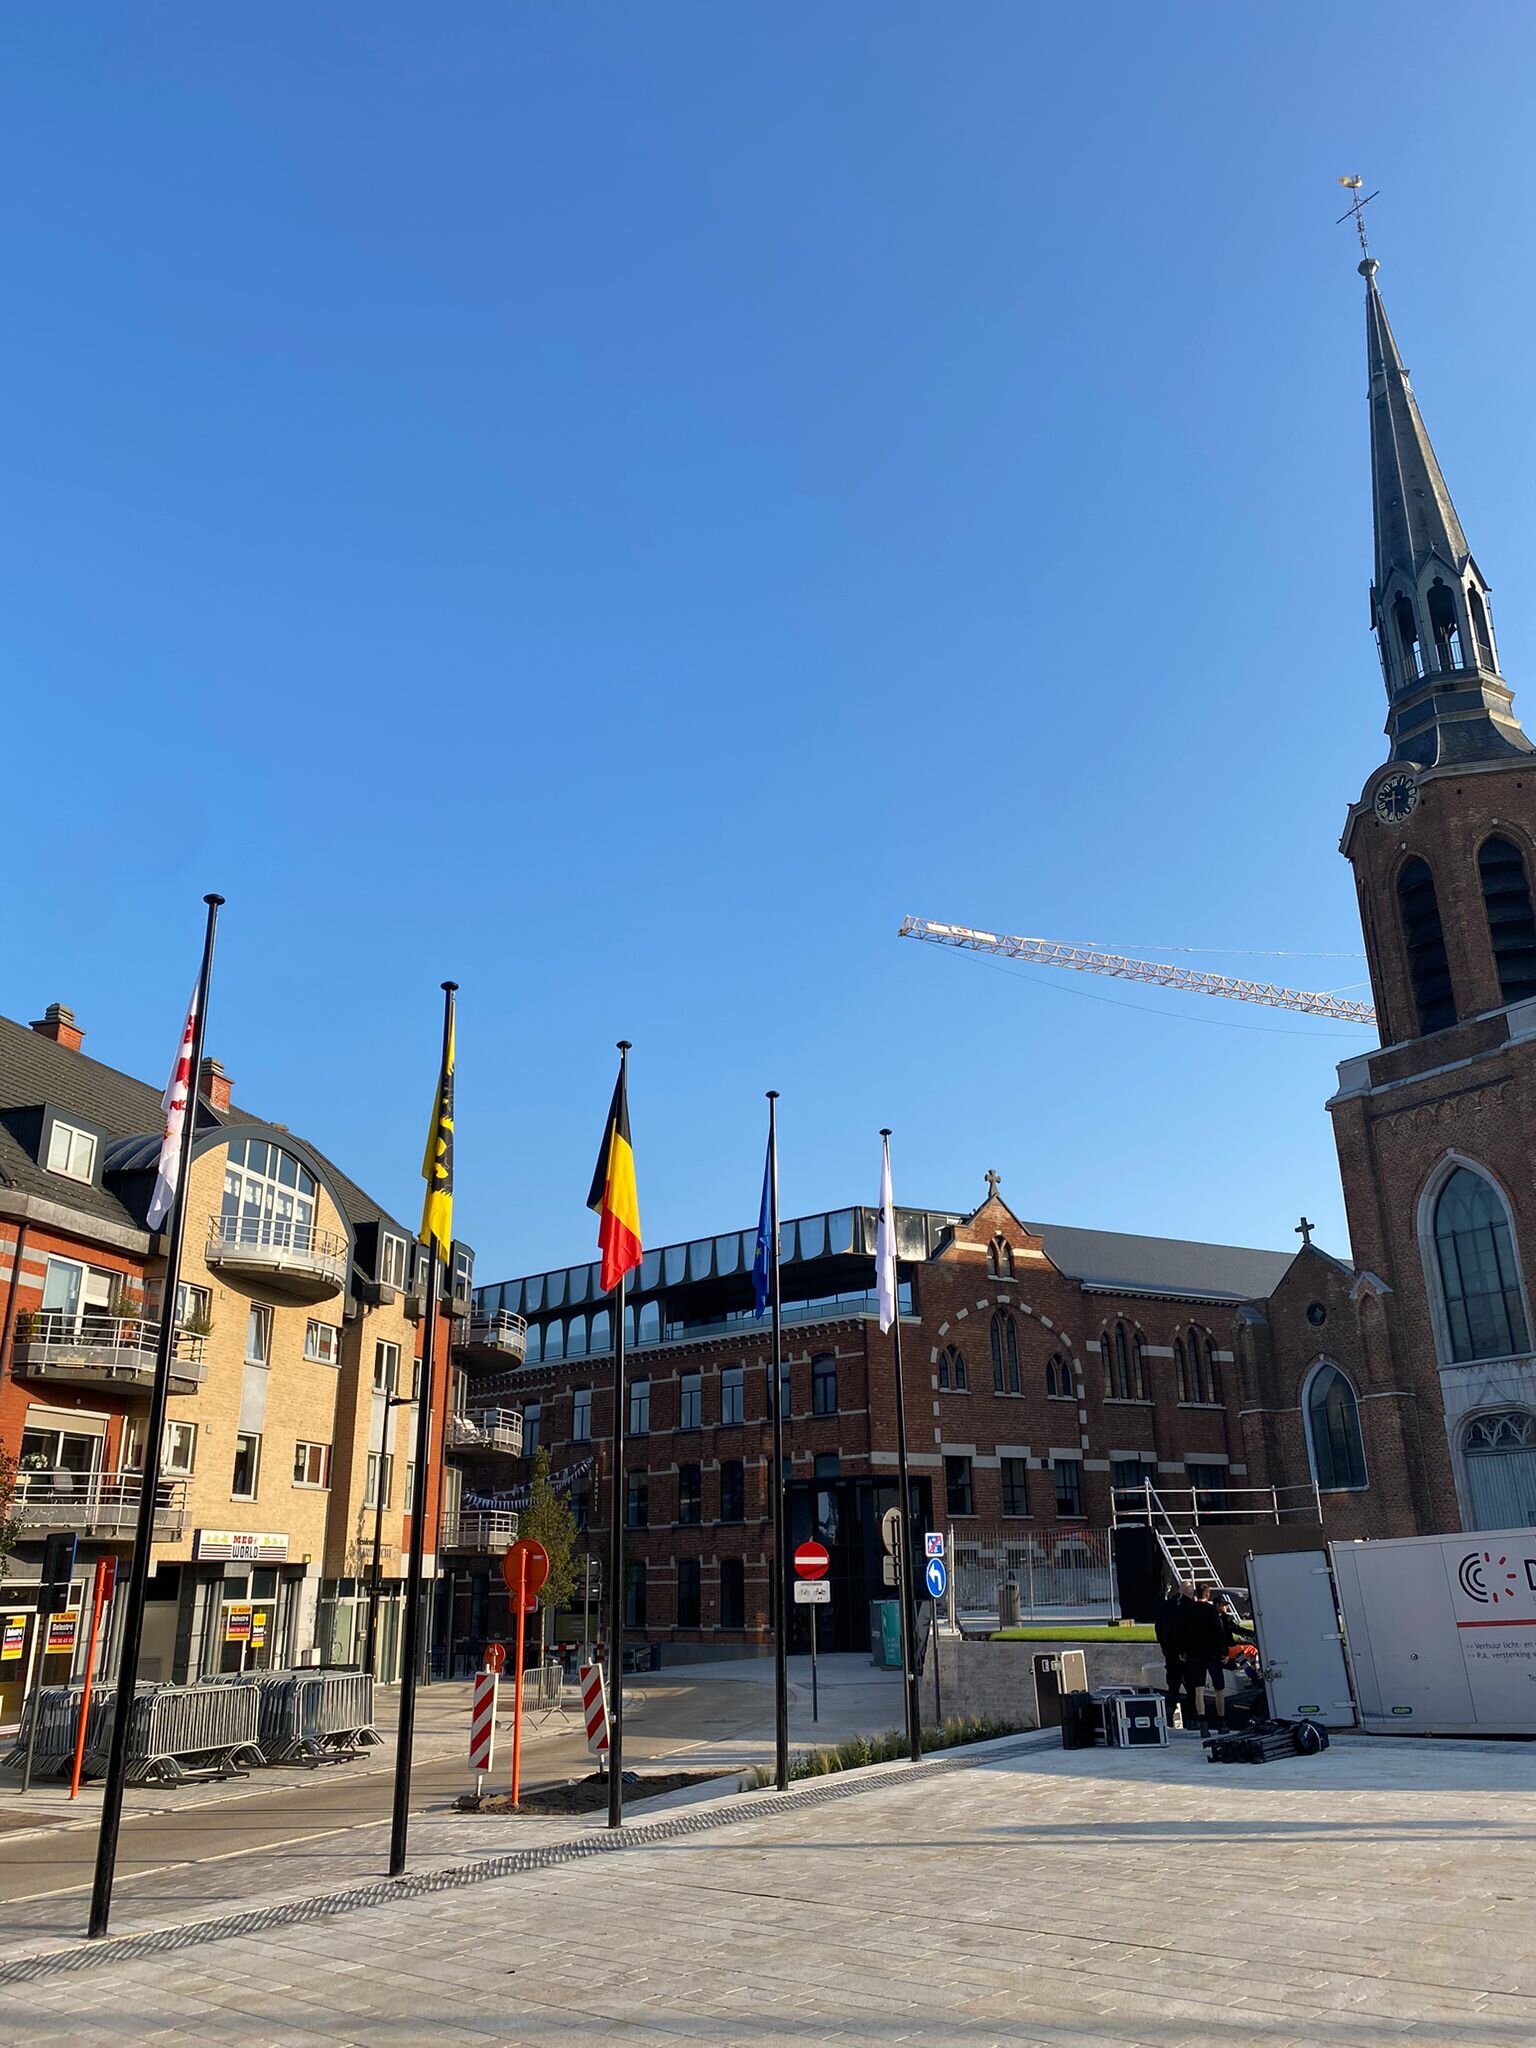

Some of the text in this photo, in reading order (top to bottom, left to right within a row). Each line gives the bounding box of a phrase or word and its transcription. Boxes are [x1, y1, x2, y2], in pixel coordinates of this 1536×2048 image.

[232, 1545, 259, 1559] WORLD
[1474, 1642, 1501, 1650] Verhuur
[1491, 1650, 1532, 1659] versterking
